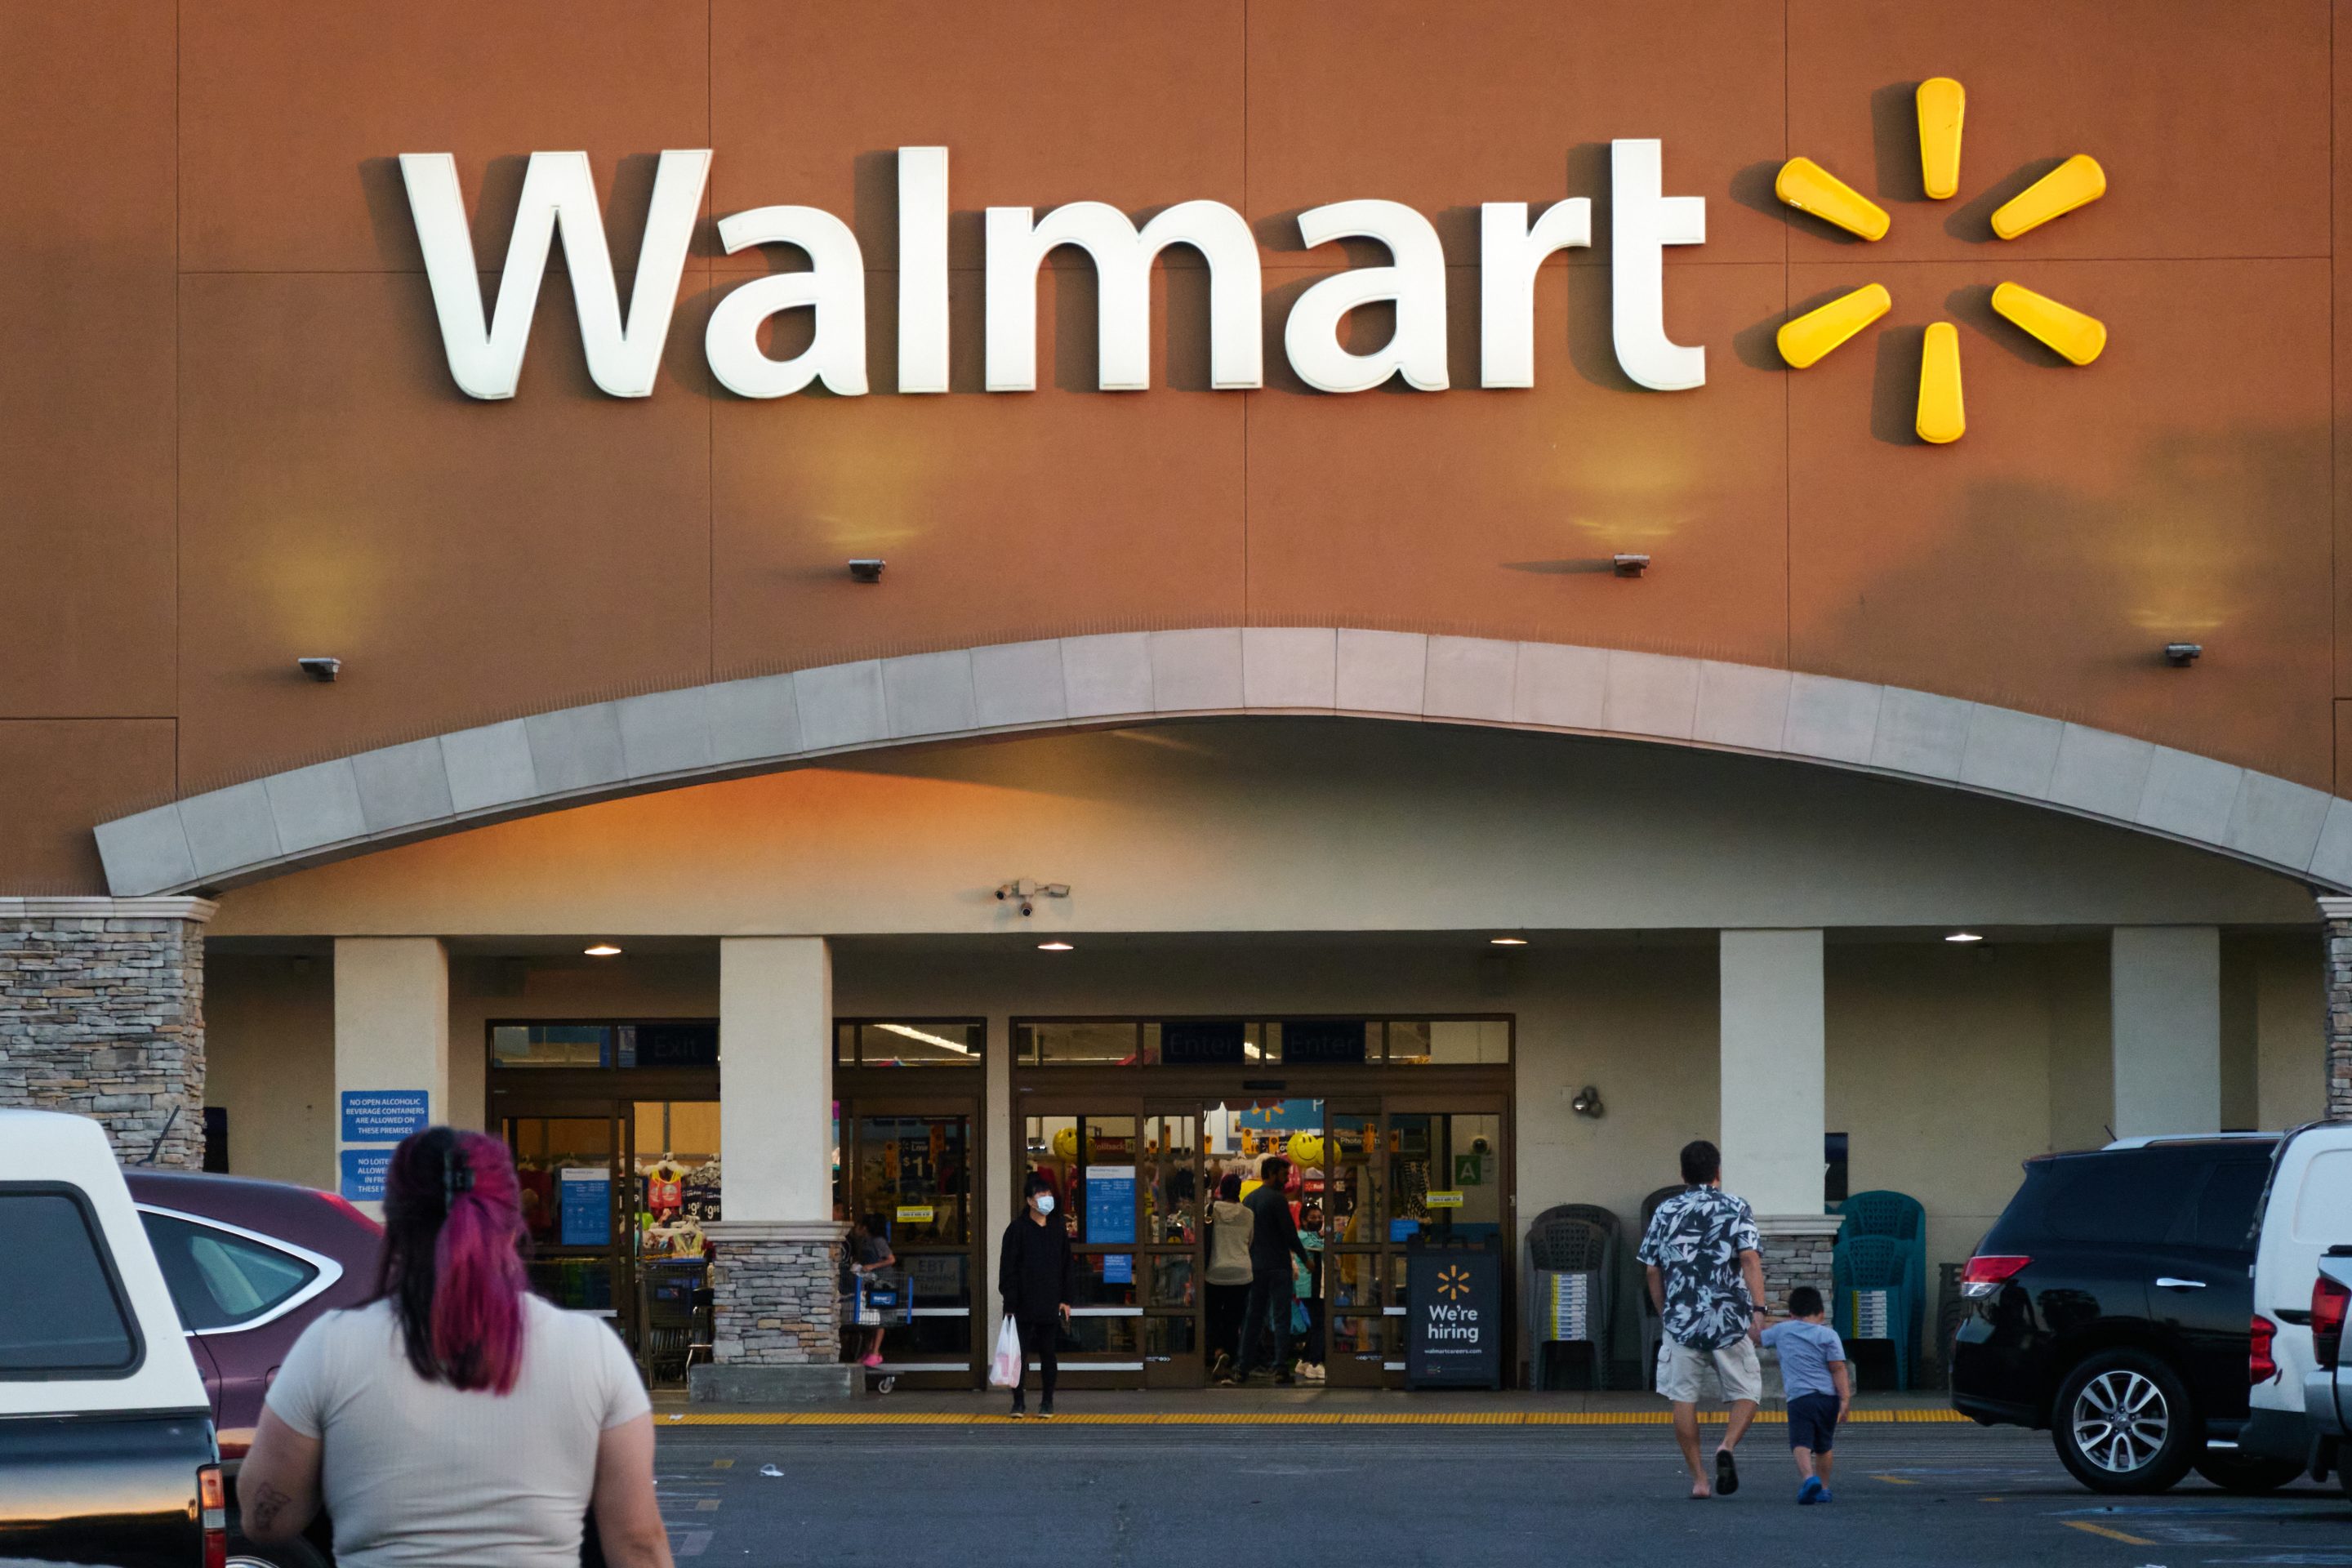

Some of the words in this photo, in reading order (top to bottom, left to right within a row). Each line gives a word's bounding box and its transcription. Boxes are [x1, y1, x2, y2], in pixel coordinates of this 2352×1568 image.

[399, 137, 1708, 400] Walmart
[654, 1035, 700, 1058] Exit
[1169, 1032, 1236, 1055] Enter
[1290, 1031, 1355, 1054] Enter
[1460, 1162, 1477, 1180] A
[919, 1260, 947, 1272] EBT
[1428, 1323, 1479, 1344] hiring
